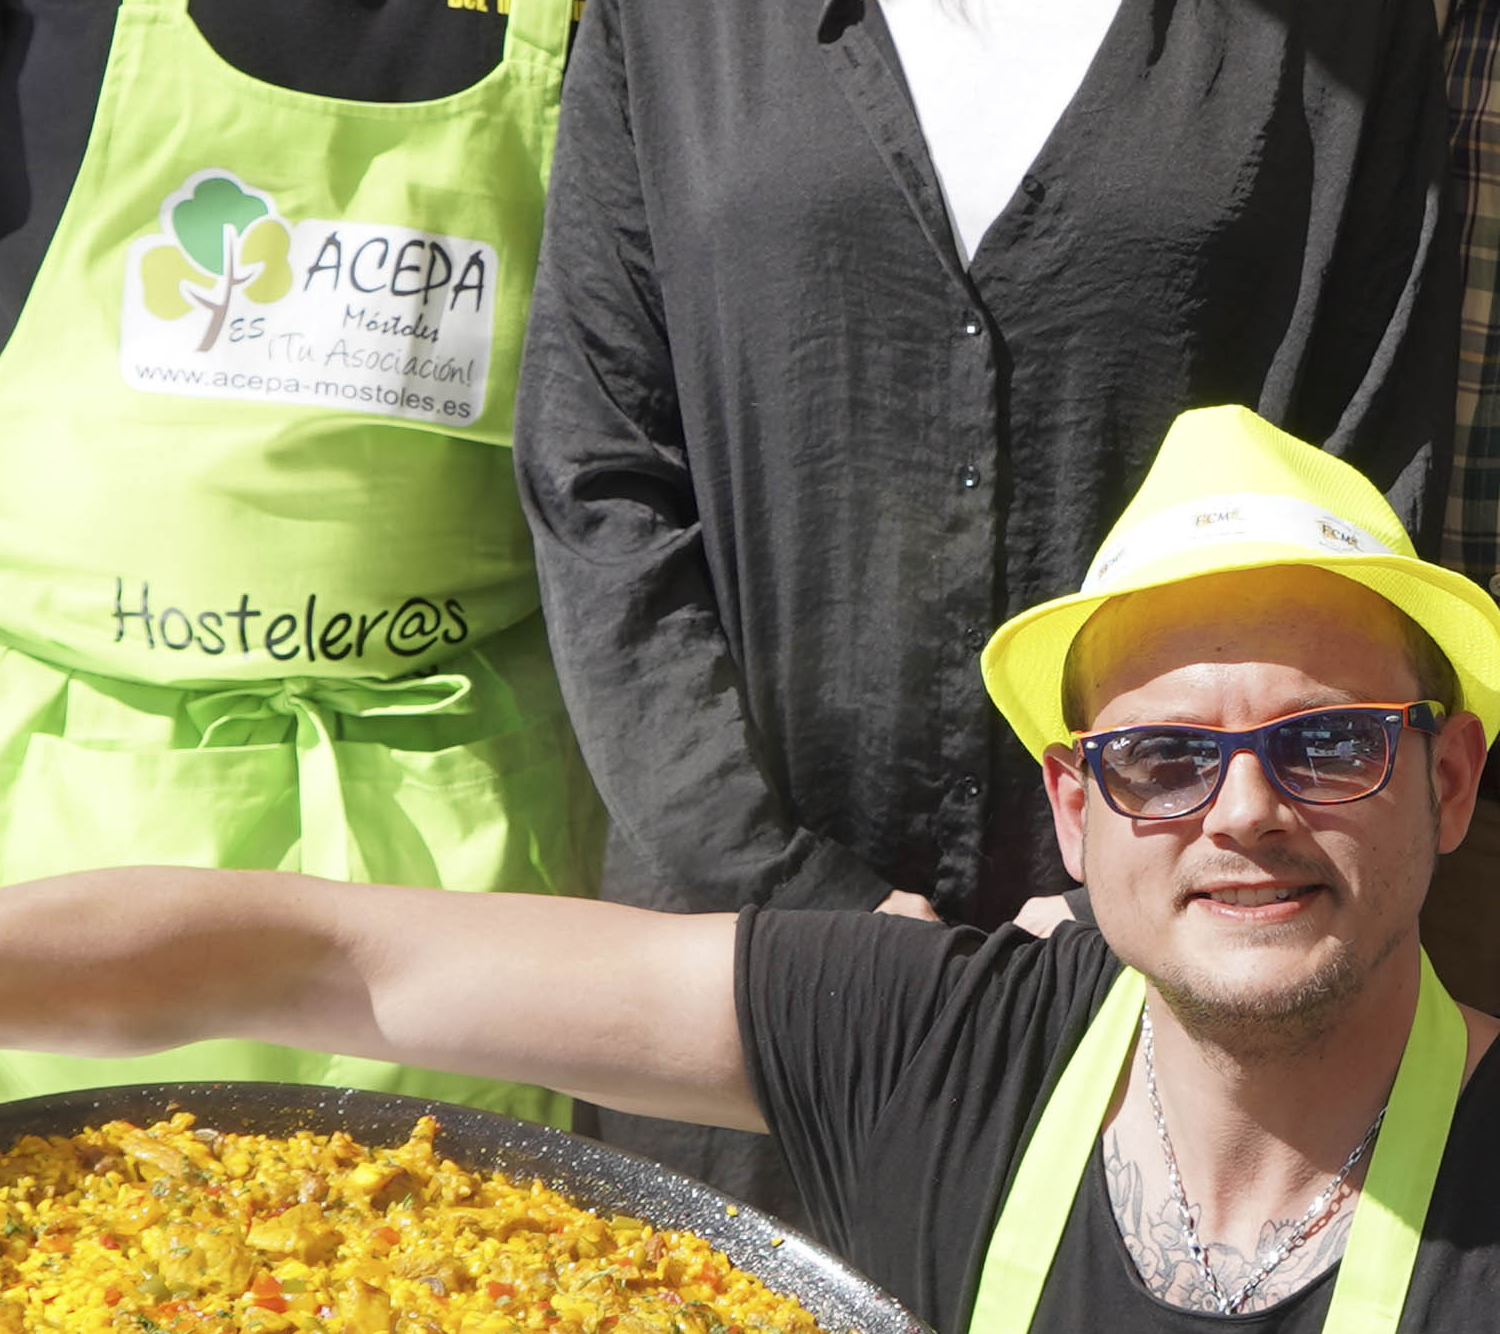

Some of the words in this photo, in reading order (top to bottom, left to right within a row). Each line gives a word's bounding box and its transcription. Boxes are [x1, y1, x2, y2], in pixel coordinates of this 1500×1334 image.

[304, 230, 485, 312] ACEPA
[228, 317, 266, 343] ES
[324, 338, 474, 388] Asociación!
[134, 364, 472, 419] www.acepa-mostoles.es
[111, 576, 469, 662] Hosteler@s
